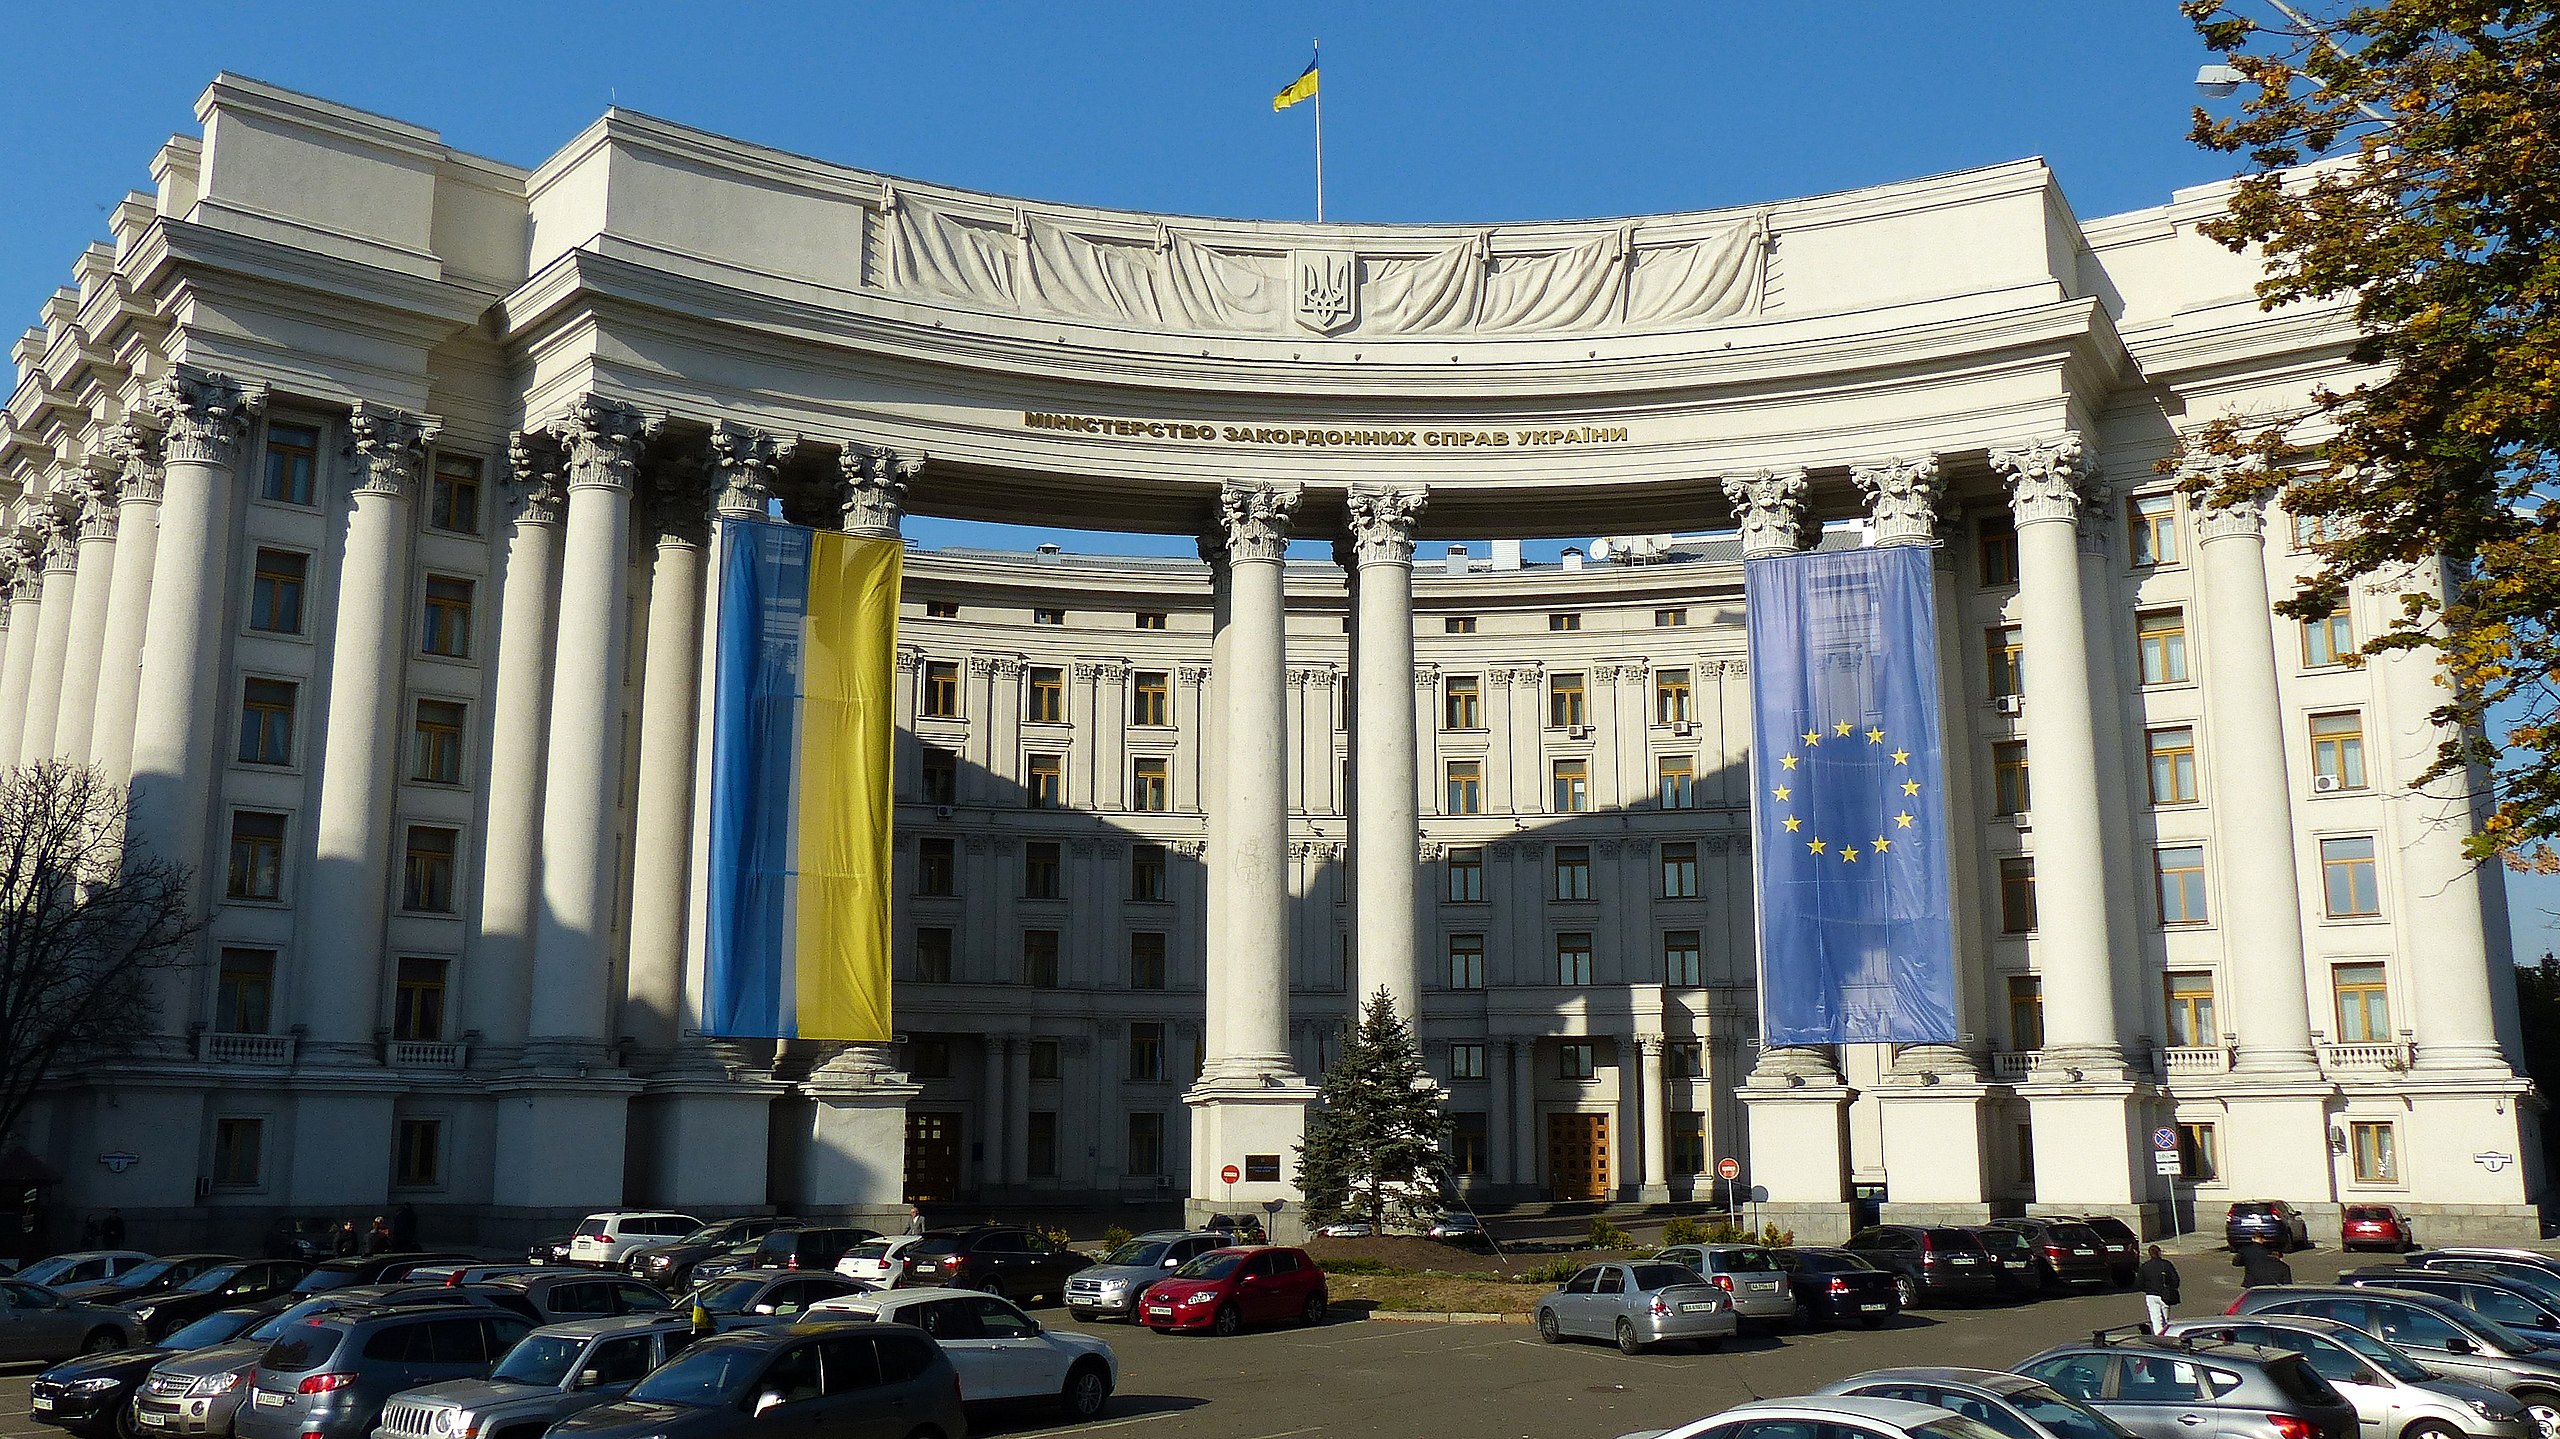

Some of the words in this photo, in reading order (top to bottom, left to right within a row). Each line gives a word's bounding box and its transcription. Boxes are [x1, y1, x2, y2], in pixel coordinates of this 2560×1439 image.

[1024, 411, 1217, 441] МІНІСТЕРСТВО
[1223, 426, 1417, 447] ЗАКОРДОННИХ
[1423, 431, 1509, 447] СПРАВ
[1516, 426, 1628, 446] УКРАЇНИ
